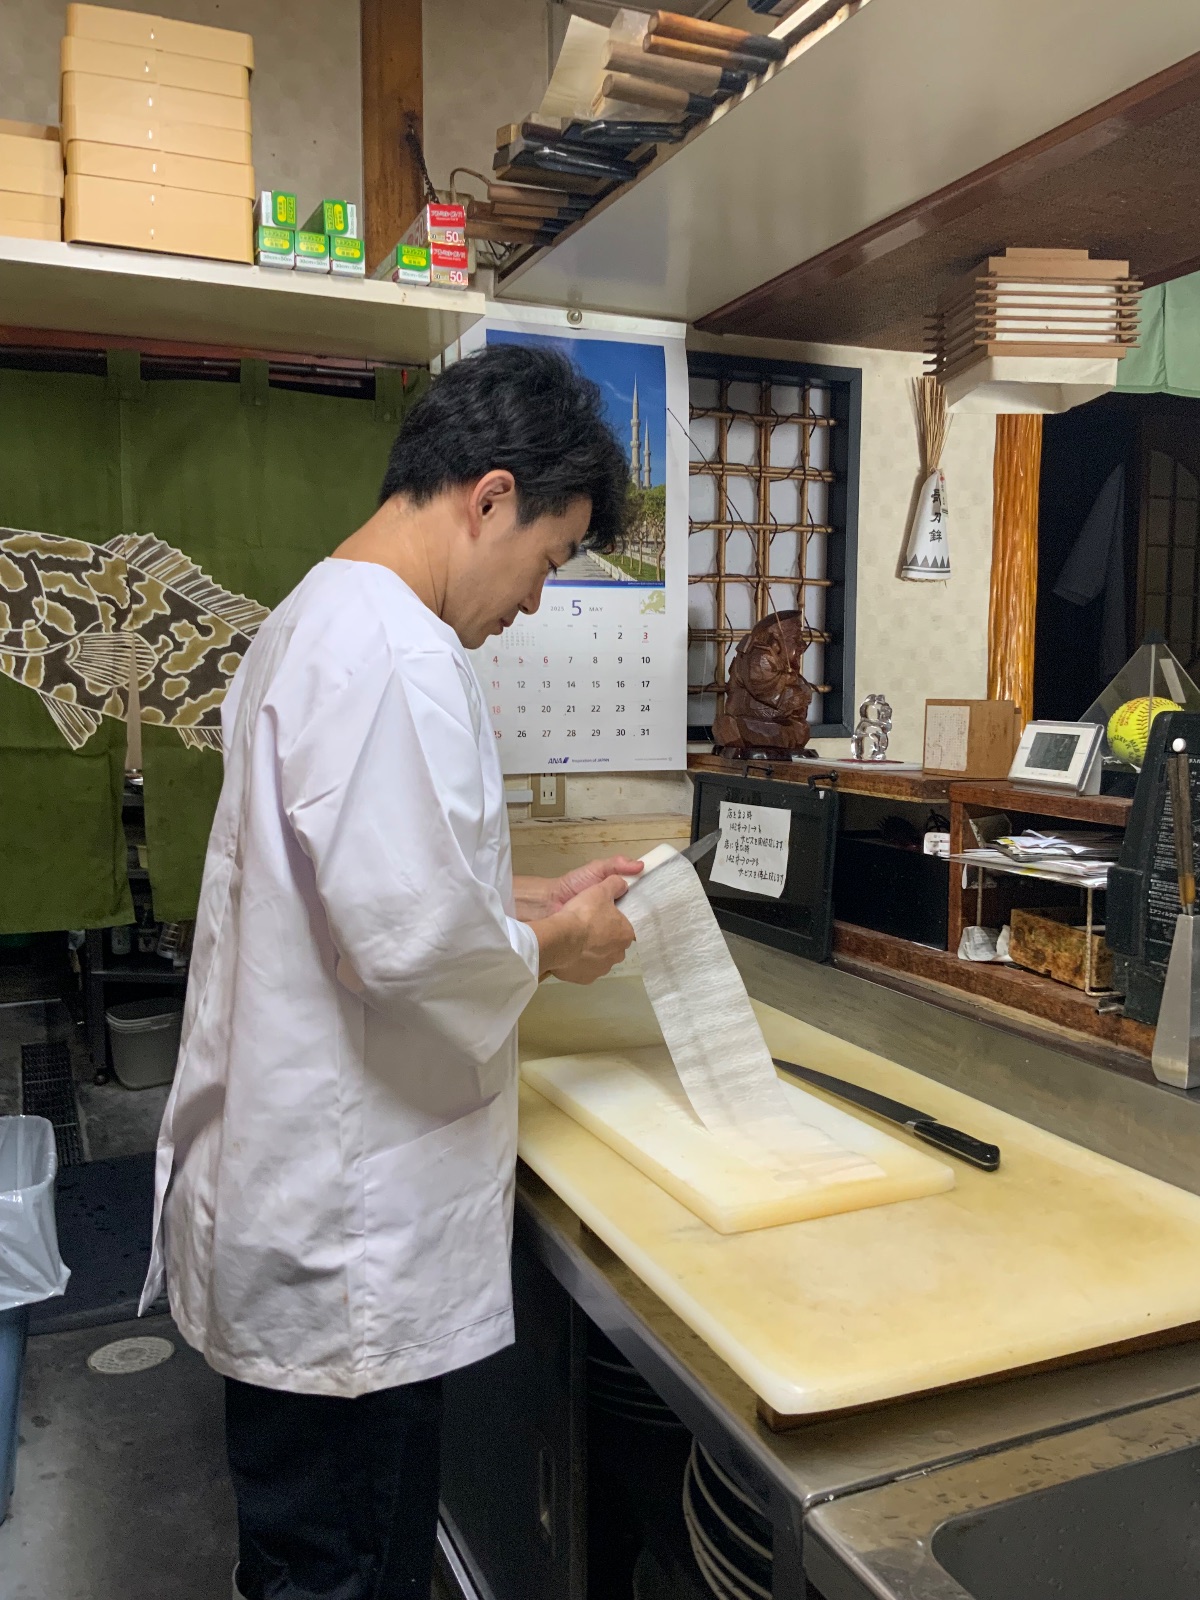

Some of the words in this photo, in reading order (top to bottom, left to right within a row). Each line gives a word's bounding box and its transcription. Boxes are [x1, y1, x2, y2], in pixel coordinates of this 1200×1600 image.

[446, 230, 458, 242] 50
[450, 270, 462, 282] 50
[571, 600, 582, 616] 5
[617, 632, 623, 640] 2
[643, 632, 648, 640] 3
[492, 656, 499, 664] 4
[543, 656, 549, 664] 6
[491, 680, 500, 688] 11
[516, 680, 526, 688] 12
[541, 680, 551, 688] 13
[591, 680, 601, 688] 15
[492, 706, 501, 714] 18
[517, 706, 526, 714] 19
[566, 704, 576, 712] 21
[590, 704, 601, 712] 22
[615, 704, 626, 712] 23
[541, 730, 552, 738] 27
[566, 730, 577, 738] 28
[591, 728, 601, 736] 29
[615, 728, 626, 736] 30
